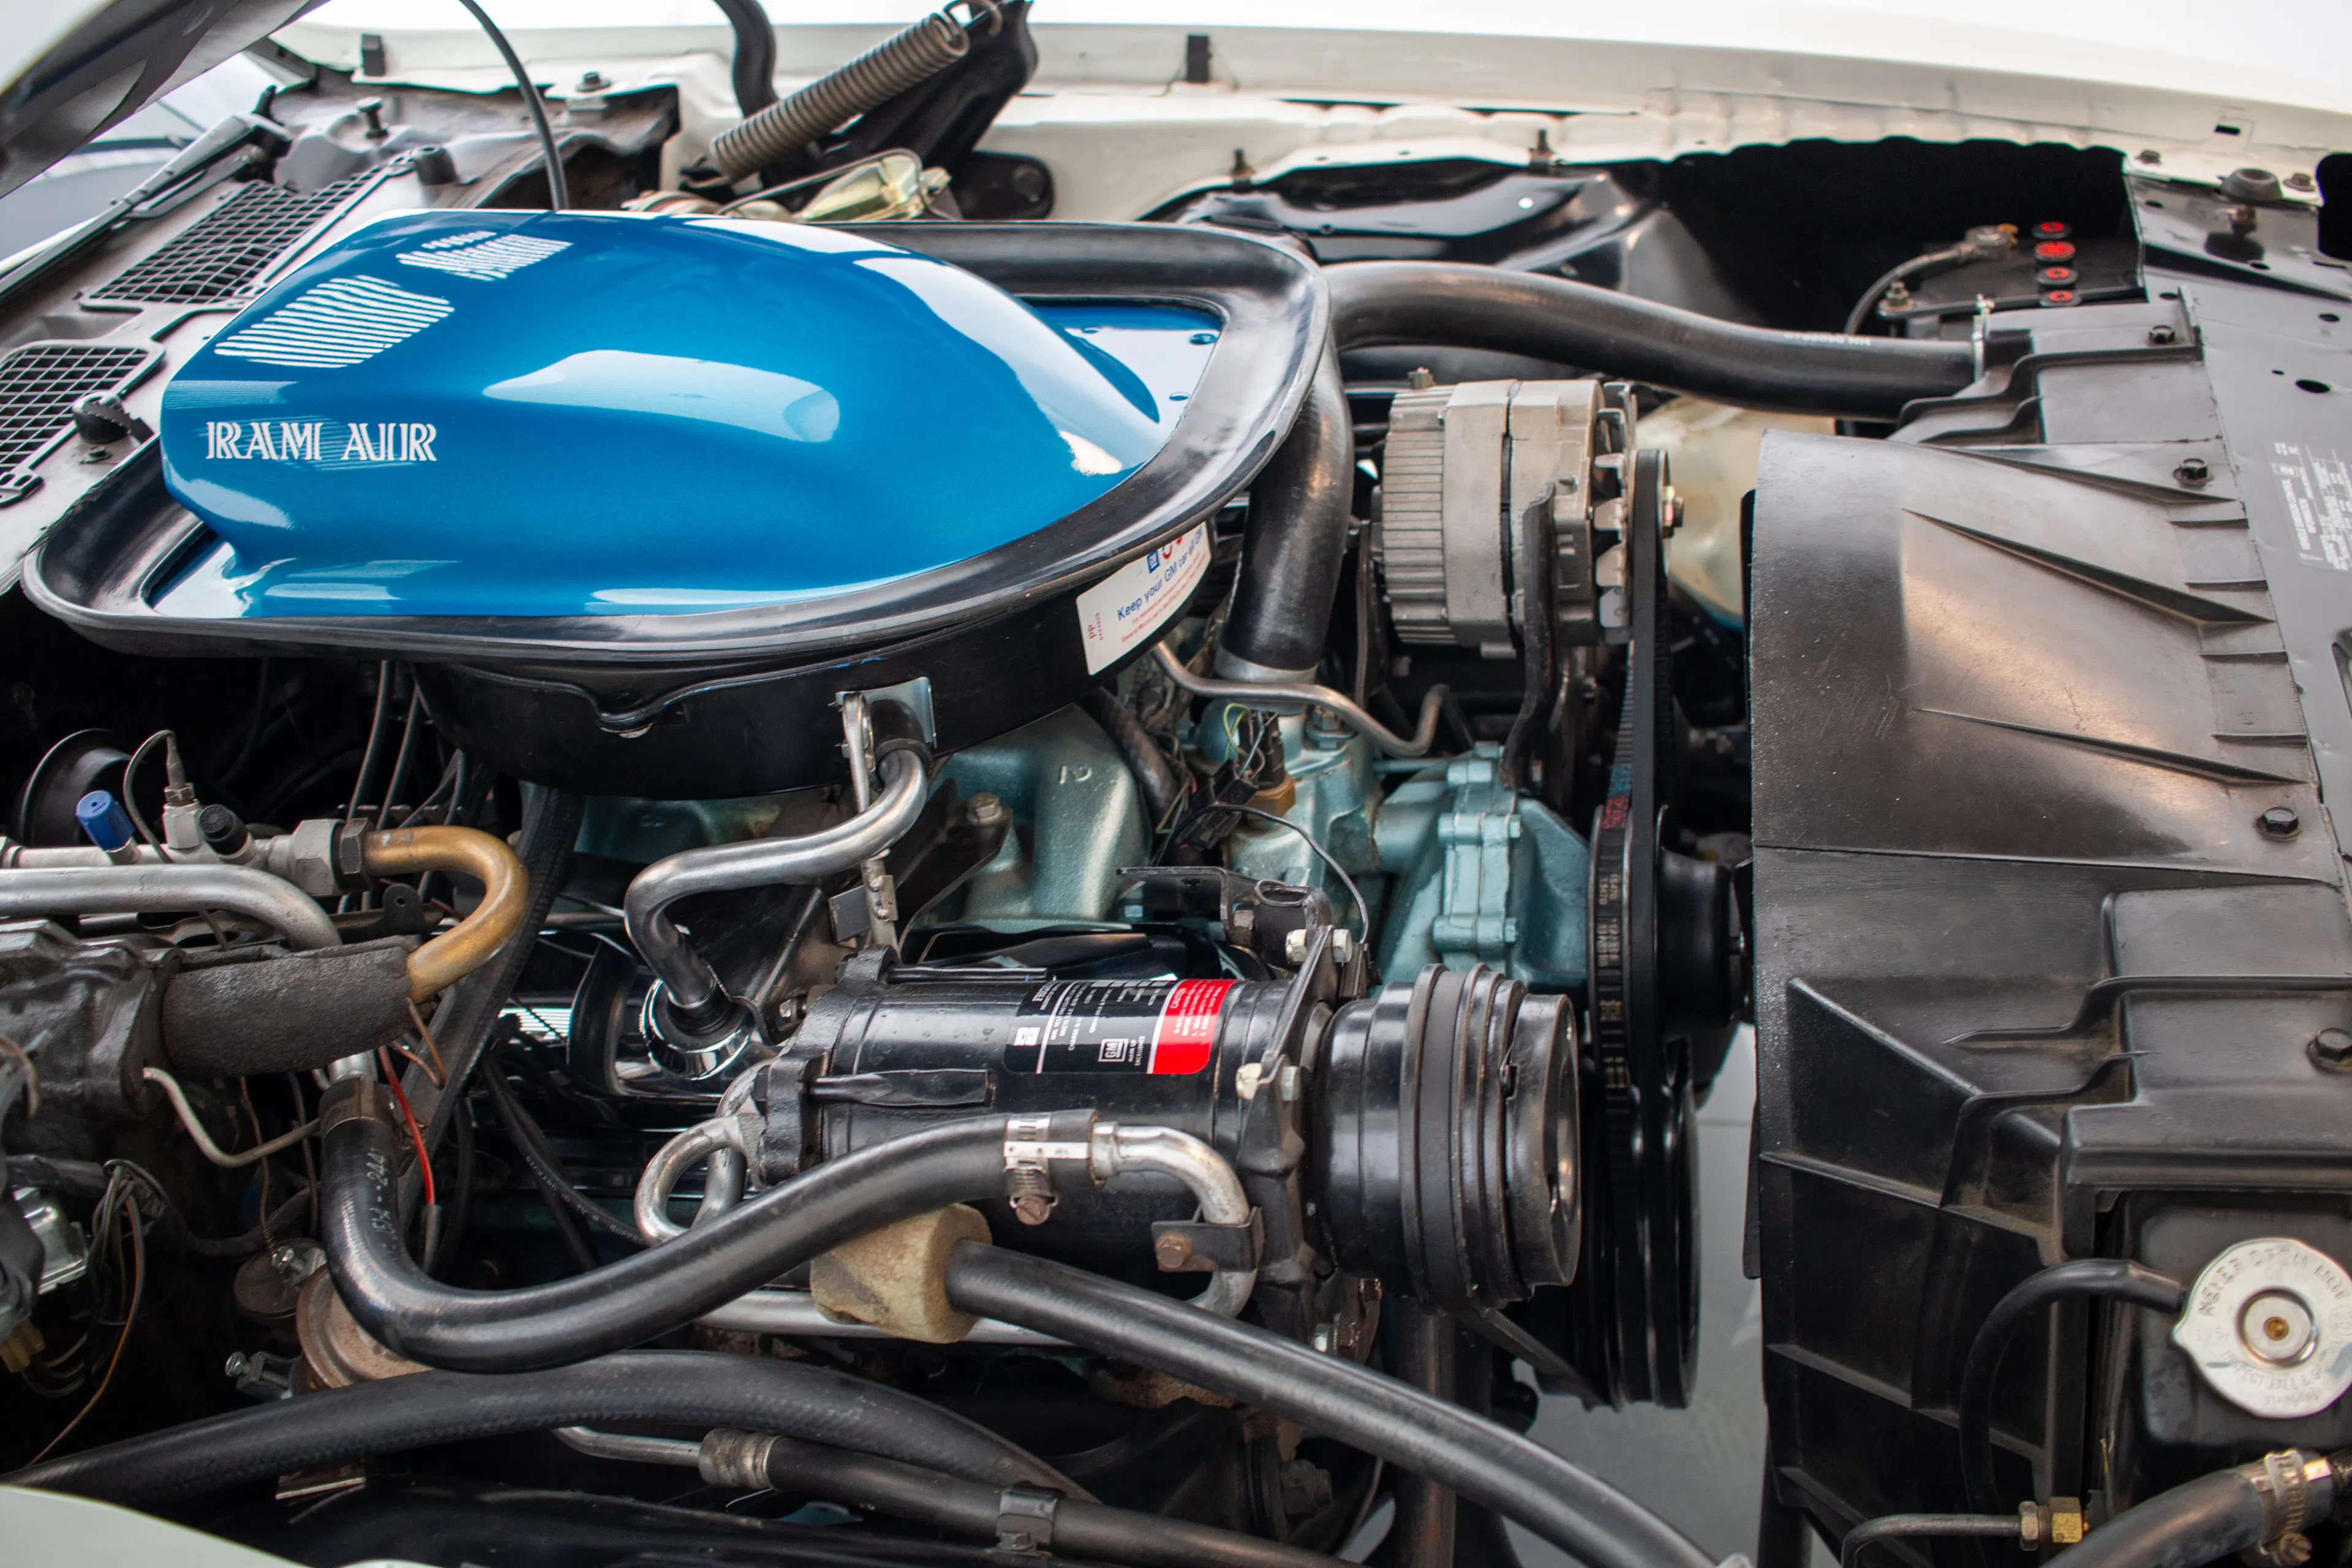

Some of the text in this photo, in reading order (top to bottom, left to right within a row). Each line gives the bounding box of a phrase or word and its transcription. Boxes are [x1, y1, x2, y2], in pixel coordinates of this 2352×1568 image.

[206, 421, 437, 461] RAM AIR
[1117, 597, 1142, 621] Keep
[1144, 578, 1163, 603] your
[1164, 562, 1177, 582] GM
[1178, 554, 1188, 568] car
[1087, 624, 1096, 639] PP
[1104, 1042, 1118, 1058] GM
[2198, 1247, 2346, 1316] NEVER OPEN HOT
